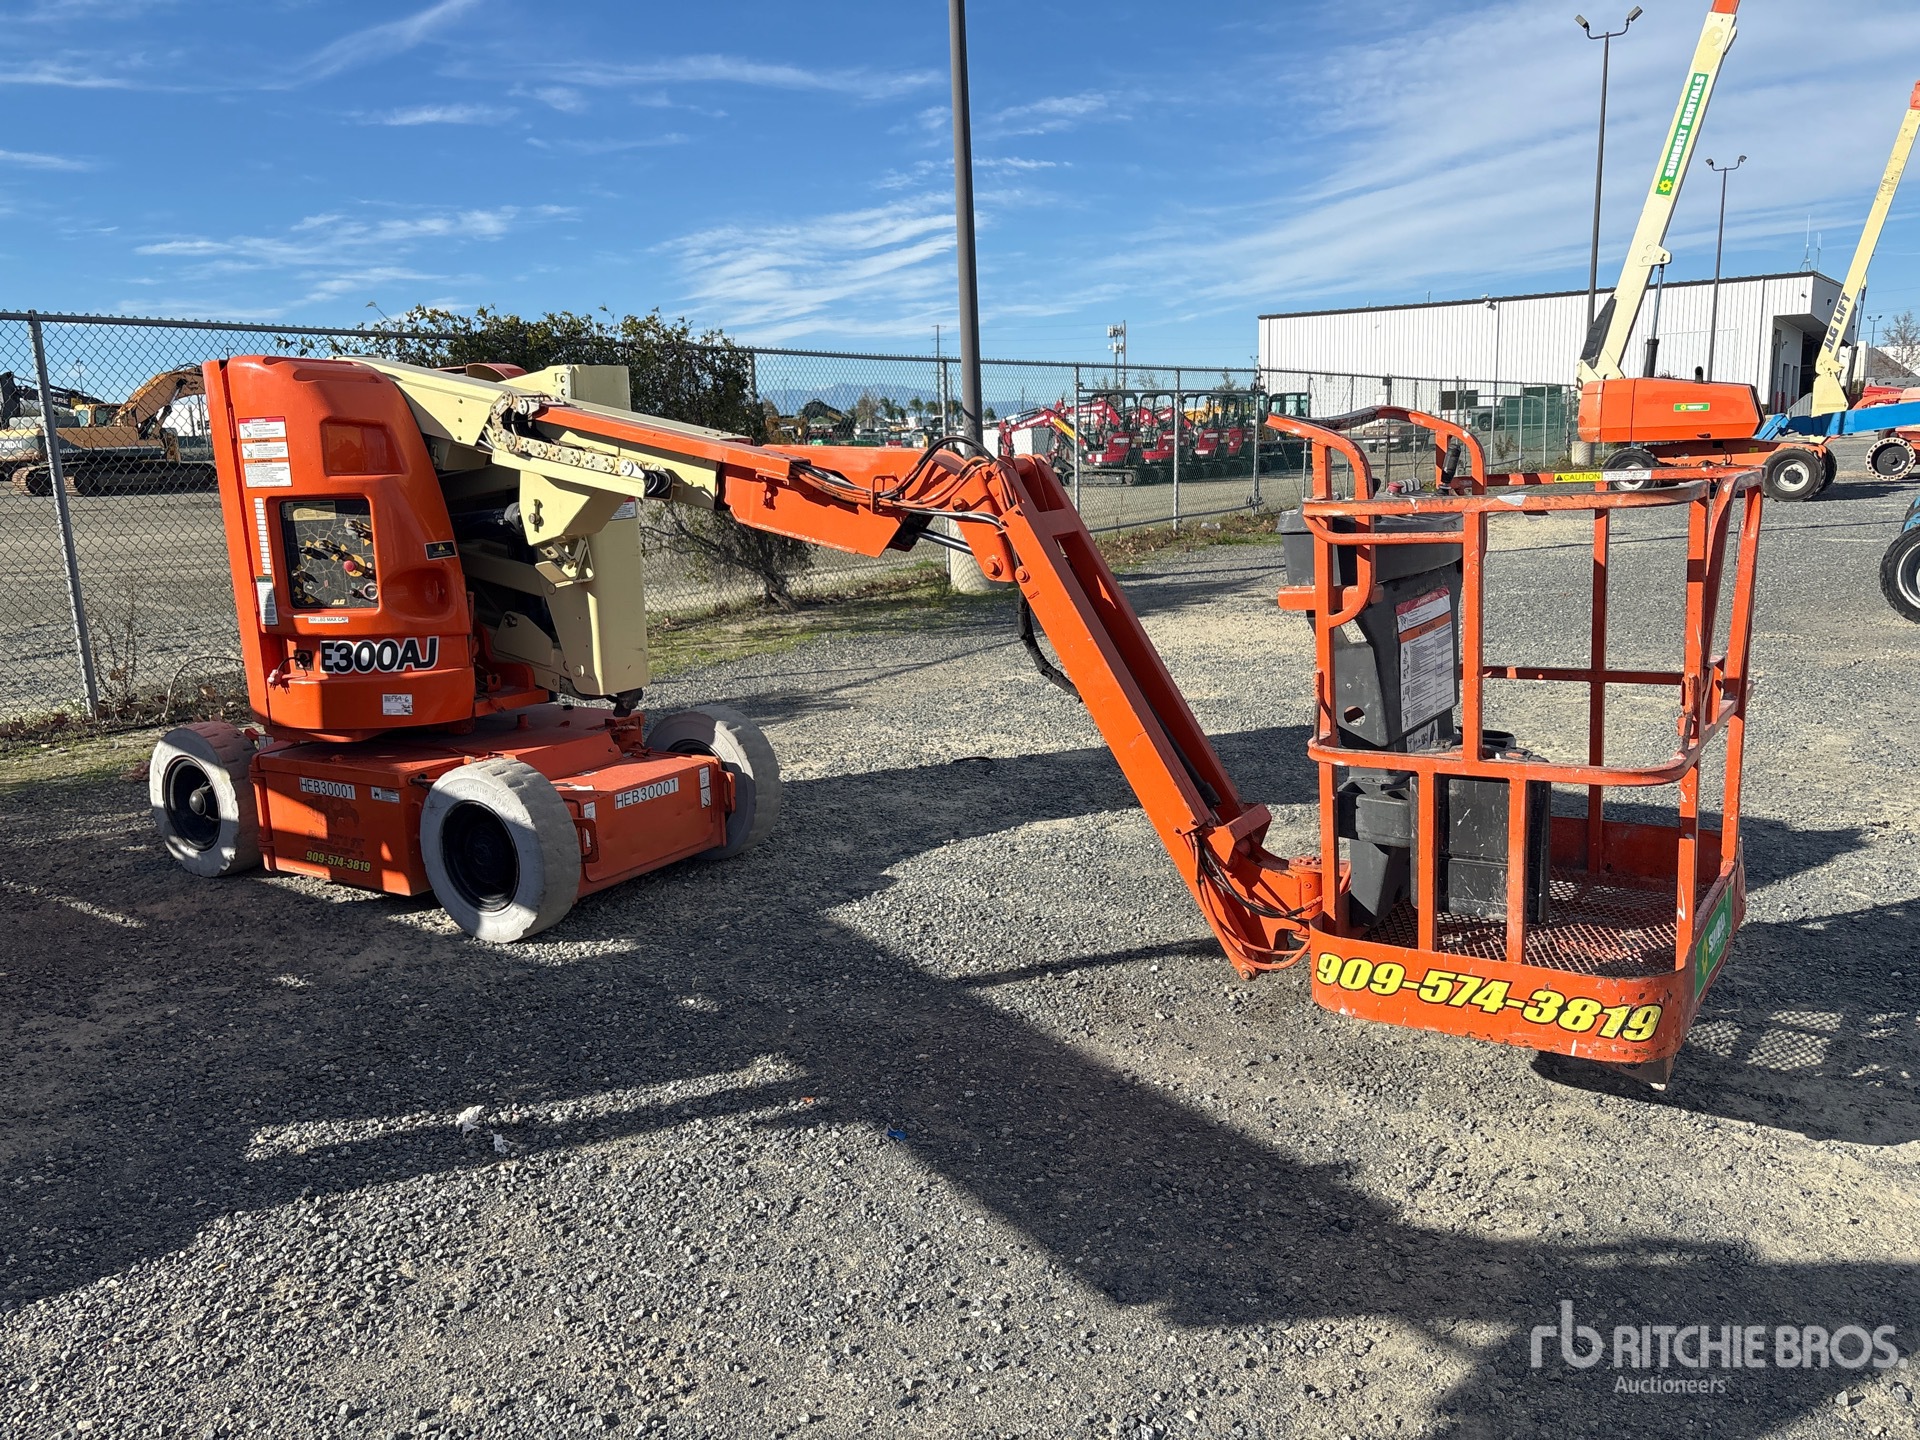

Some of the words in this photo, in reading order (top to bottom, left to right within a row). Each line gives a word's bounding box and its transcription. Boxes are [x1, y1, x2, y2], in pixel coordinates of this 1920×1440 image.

[1665, 127, 1688, 177] SUNBELT
[1681, 75, 1705, 126] RENTALS
[1824, 326, 1839, 353] JLG
[1833, 292, 1851, 325] LIFT
[1563, 473, 1600, 481] CAUTION
[320, 637, 438, 673] E300AJ
[301, 779, 353, 798] HEB30001
[615, 779, 678, 809] HEB30001
[306, 850, 371, 872] 909-574-3819
[1315, 952, 1663, 1041] 909-574-3819
